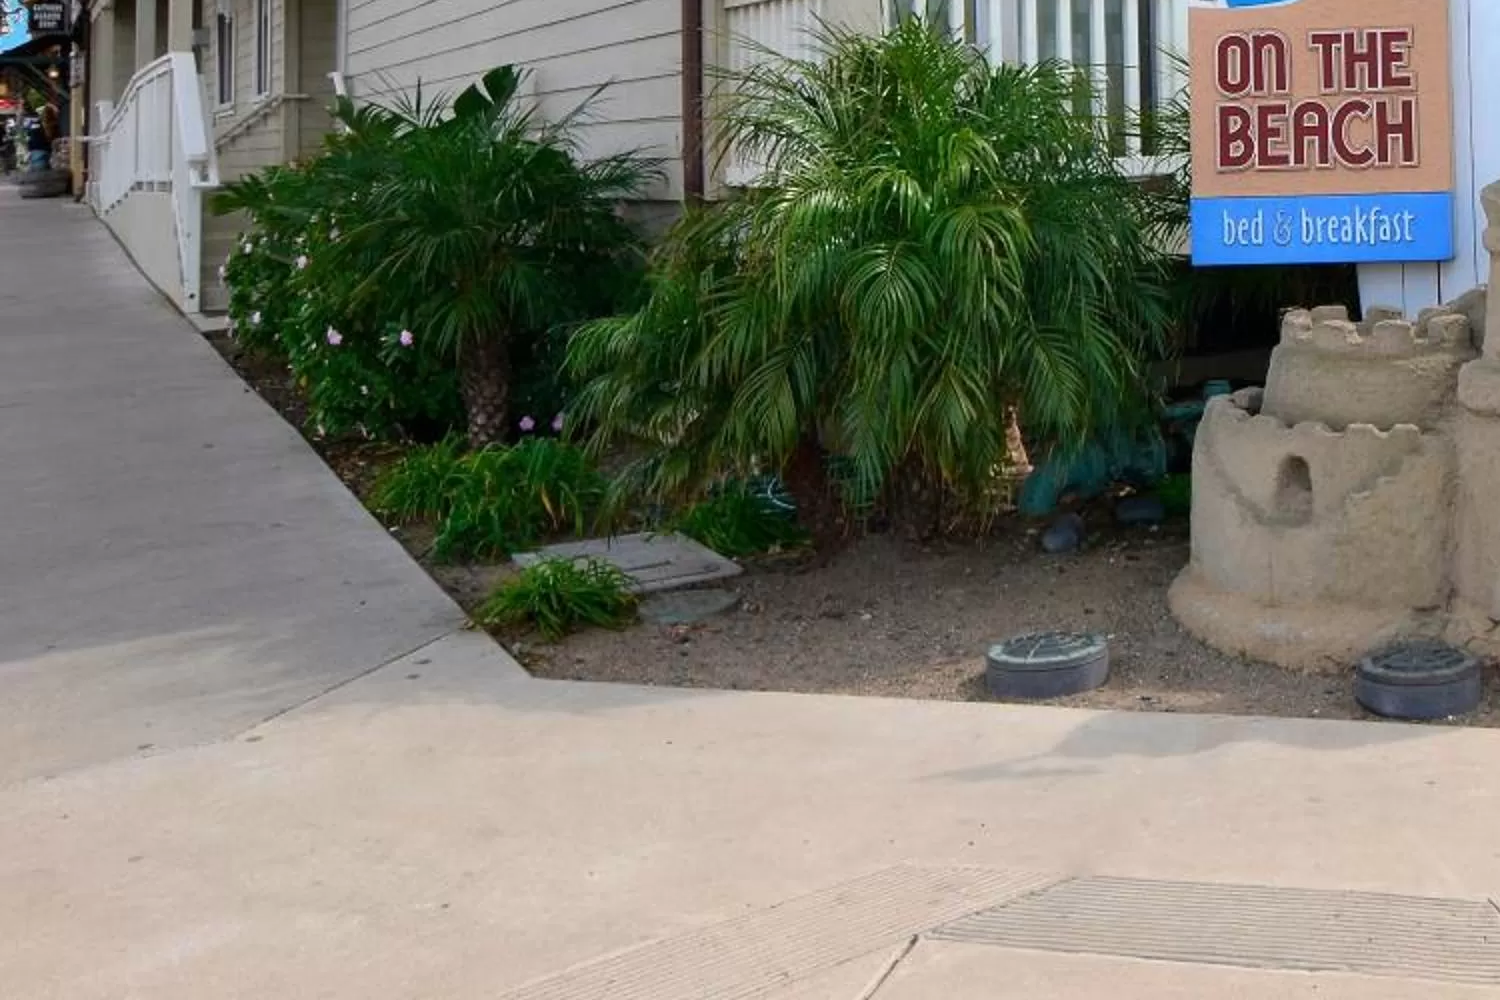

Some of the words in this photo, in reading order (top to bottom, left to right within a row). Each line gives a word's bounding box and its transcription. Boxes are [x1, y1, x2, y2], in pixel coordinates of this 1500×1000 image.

[1216, 31, 1288, 95] ON
[1310, 29, 1413, 91] THE
[1218, 99, 1417, 168] BEACH
[1222, 208, 1264, 245] bed
[1272, 209, 1294, 246] &
[1301, 206, 1416, 245] breakfast
